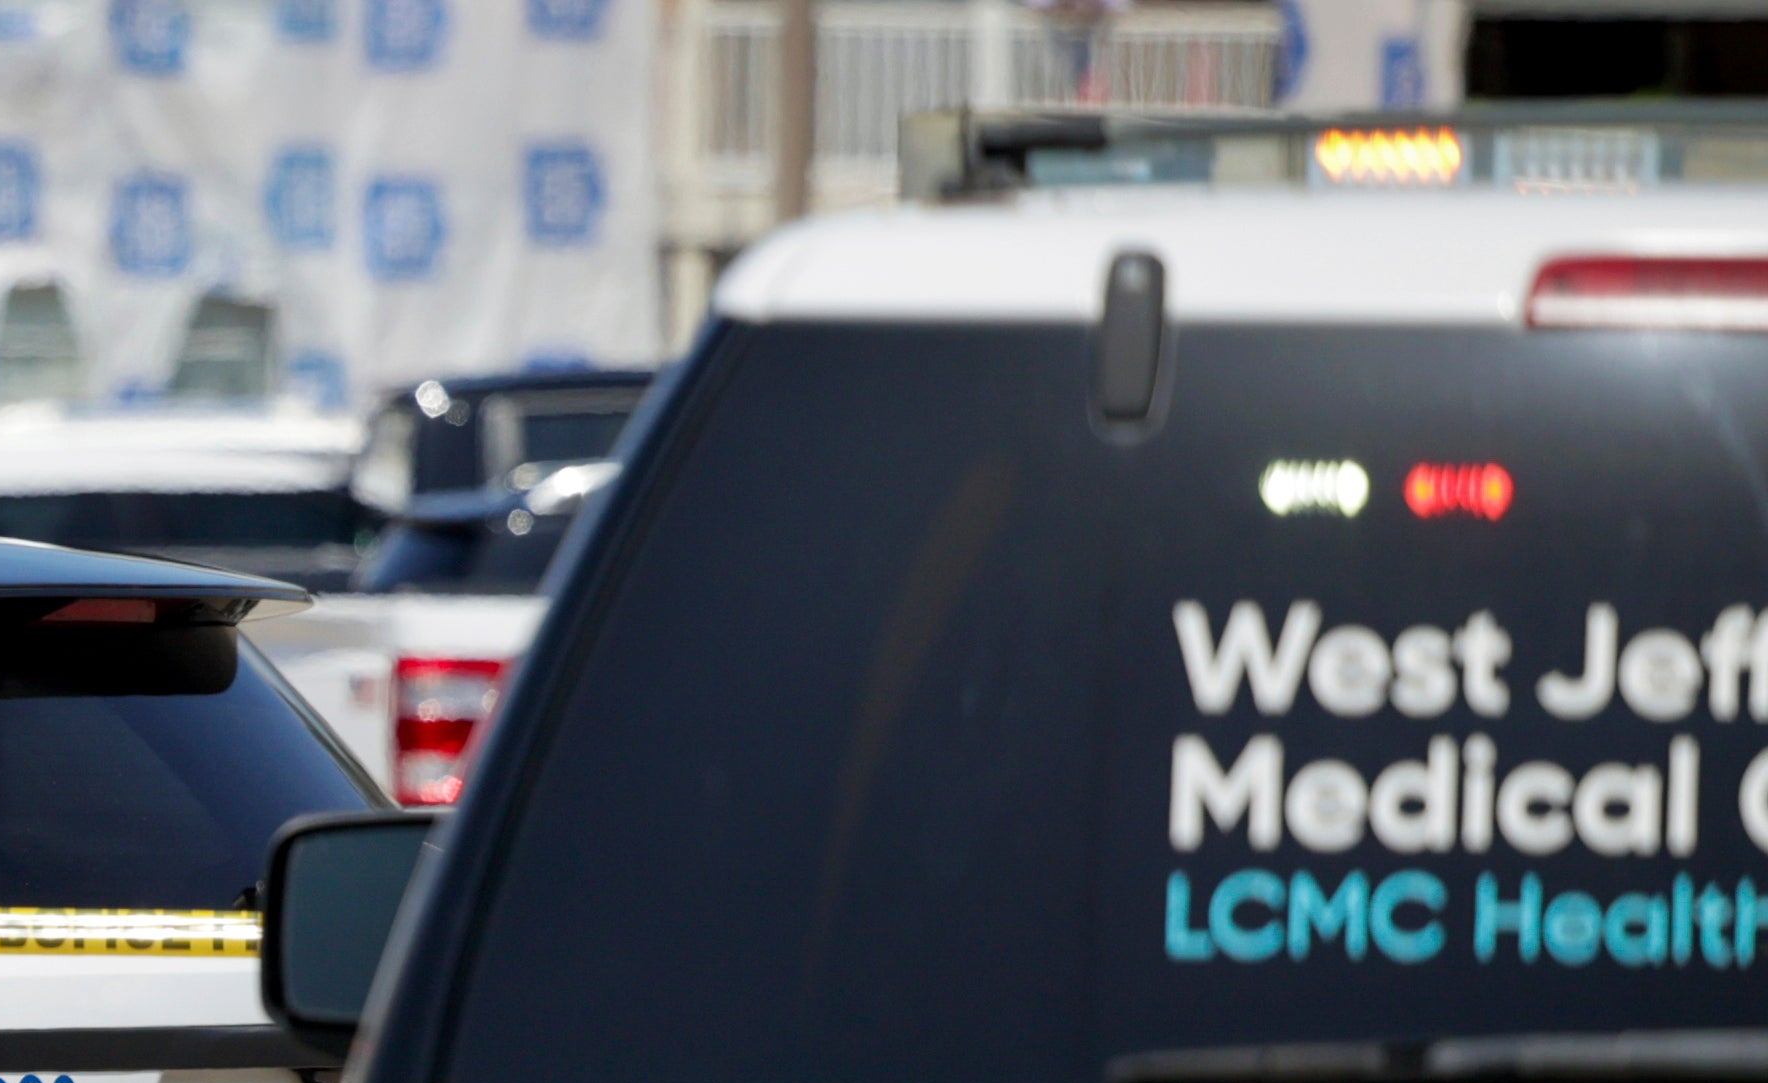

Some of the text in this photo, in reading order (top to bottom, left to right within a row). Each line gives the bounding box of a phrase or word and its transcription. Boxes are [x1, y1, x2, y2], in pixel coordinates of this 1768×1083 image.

[1172, 600, 1512, 718] West
[1169, 732, 1701, 857] Medical
[1164, 869, 1447, 963] LCMC
